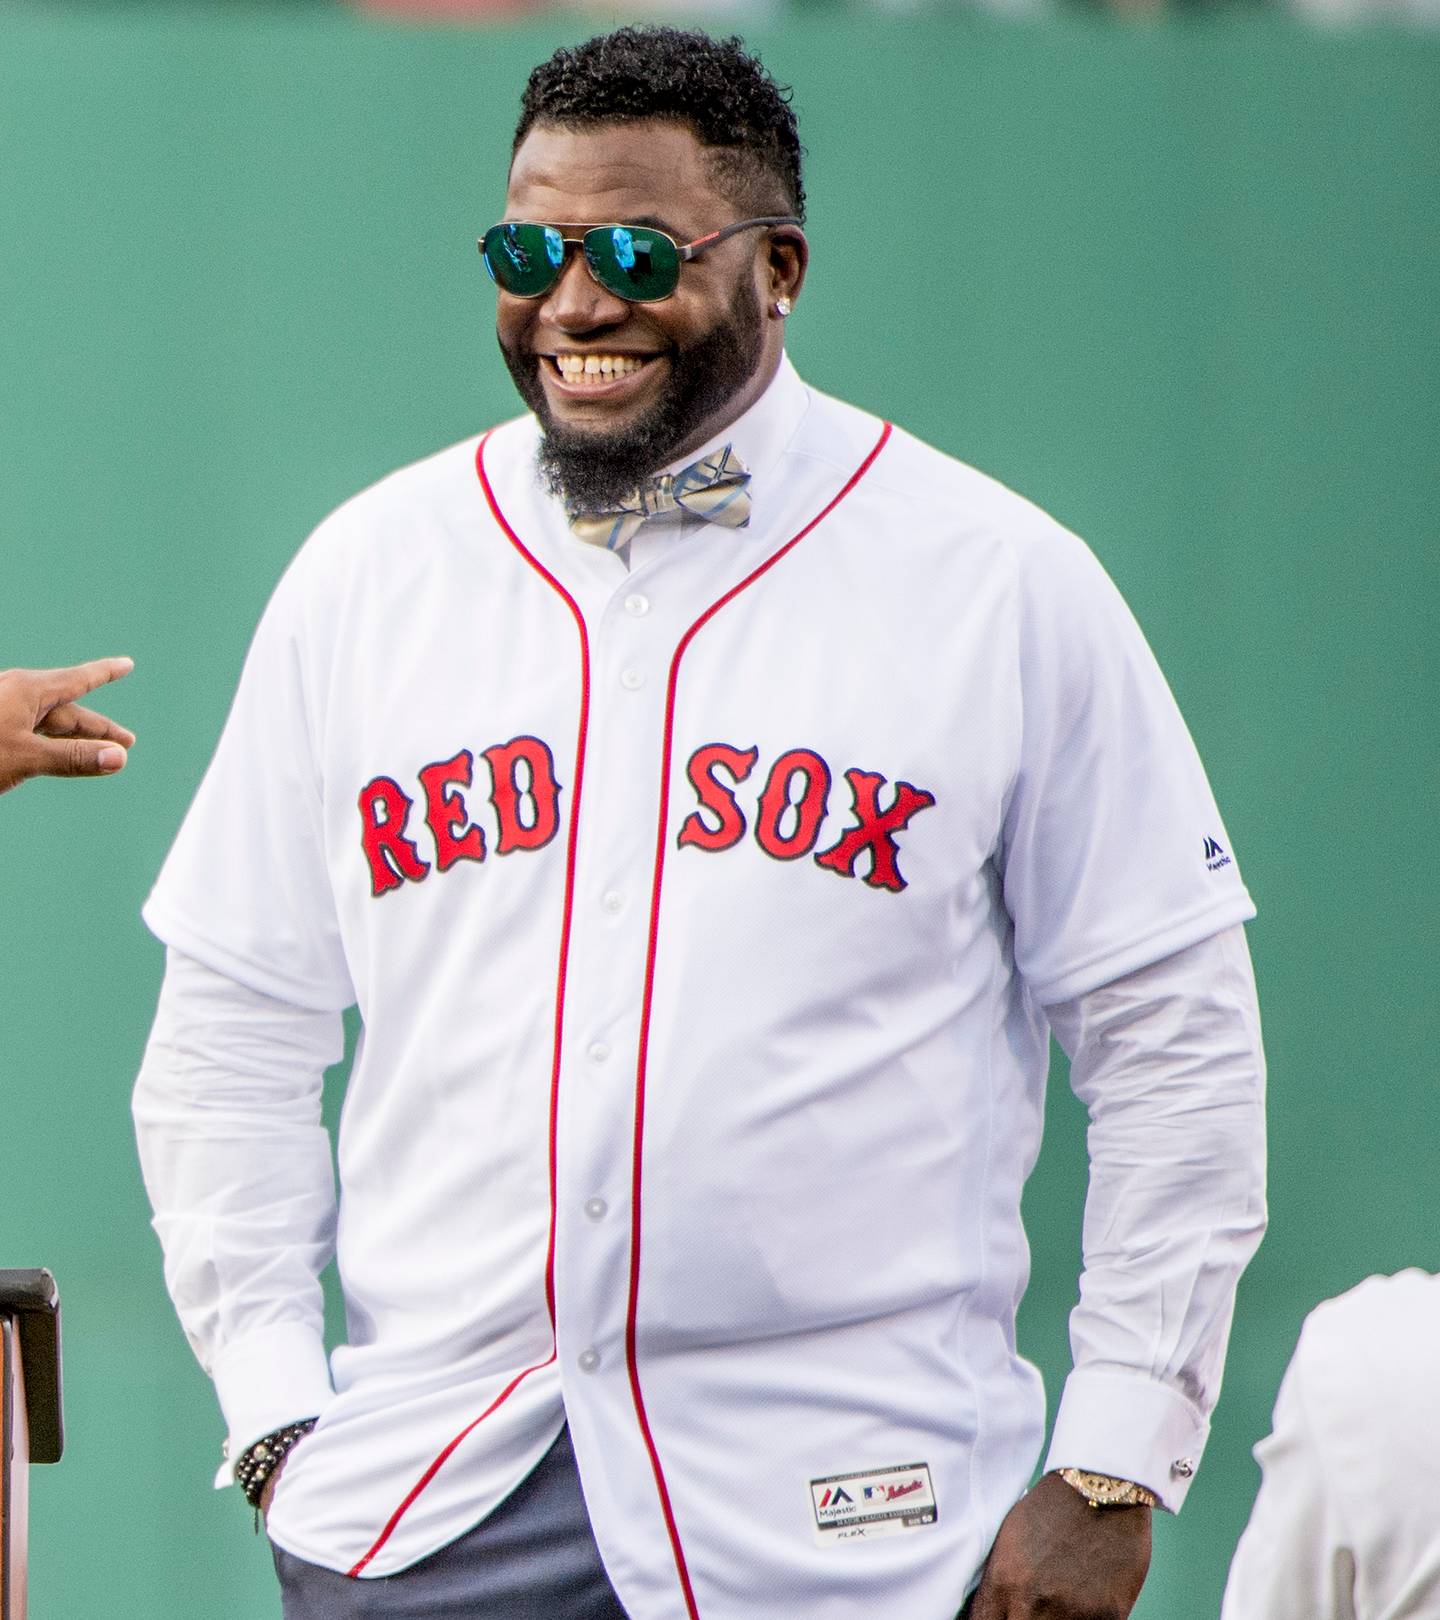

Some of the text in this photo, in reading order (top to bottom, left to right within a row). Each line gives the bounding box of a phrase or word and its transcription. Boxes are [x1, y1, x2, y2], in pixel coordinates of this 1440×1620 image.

[358, 735, 937, 898] RED SOX
[818, 1504, 857, 1519] Majestic
